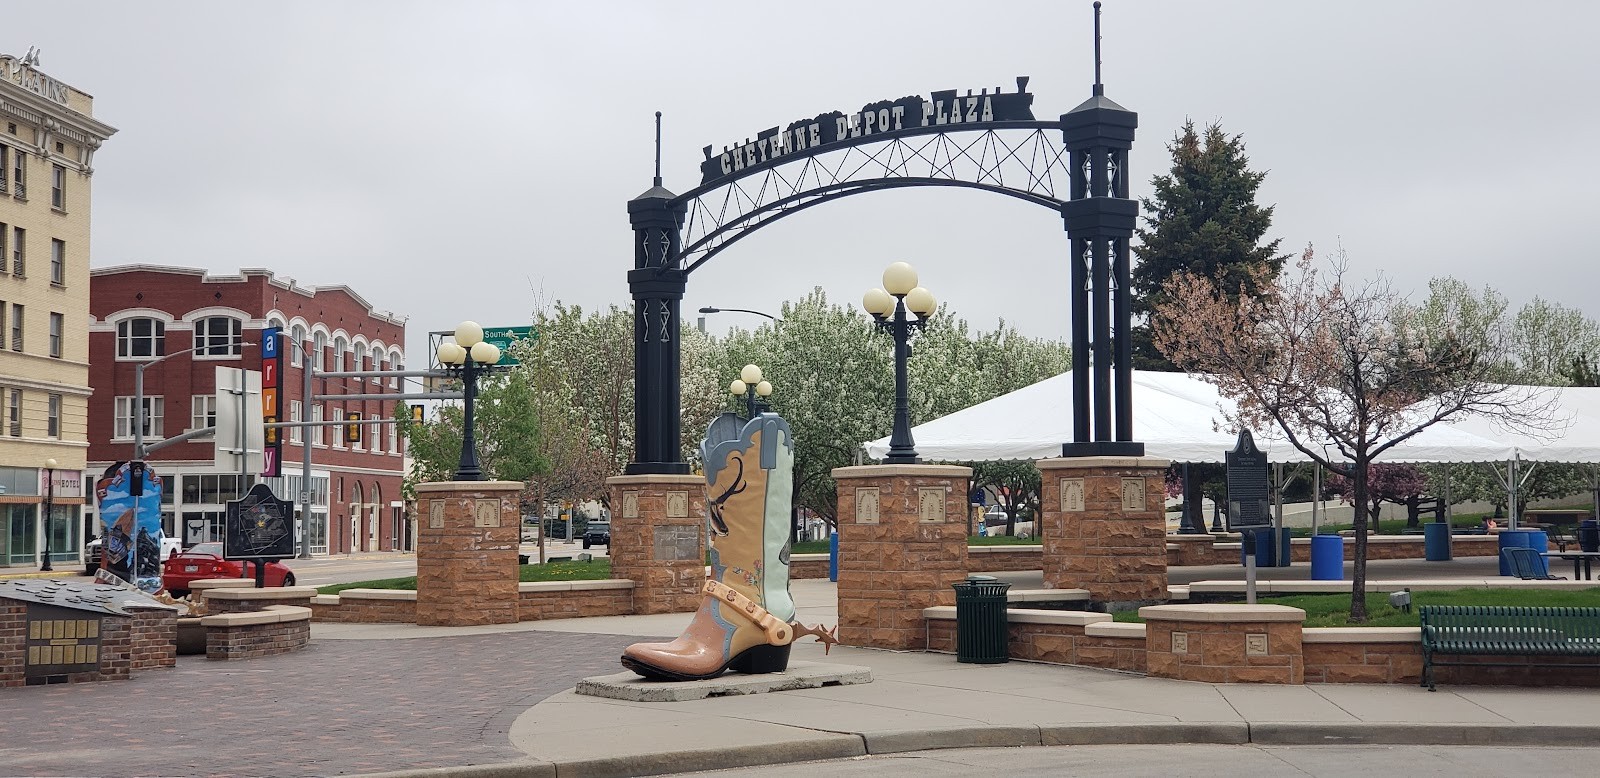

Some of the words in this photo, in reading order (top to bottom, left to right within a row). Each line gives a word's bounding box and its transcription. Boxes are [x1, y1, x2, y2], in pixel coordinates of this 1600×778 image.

[721, 123, 821, 175] CHEYENNE
[836, 106, 904, 141] DEPOT
[921, 96, 994, 127] PLAZA
[484, 330, 506, 338] SOUTH
[266, 335, 275, 473] arry
[61, 480, 80, 488] HOTEL
